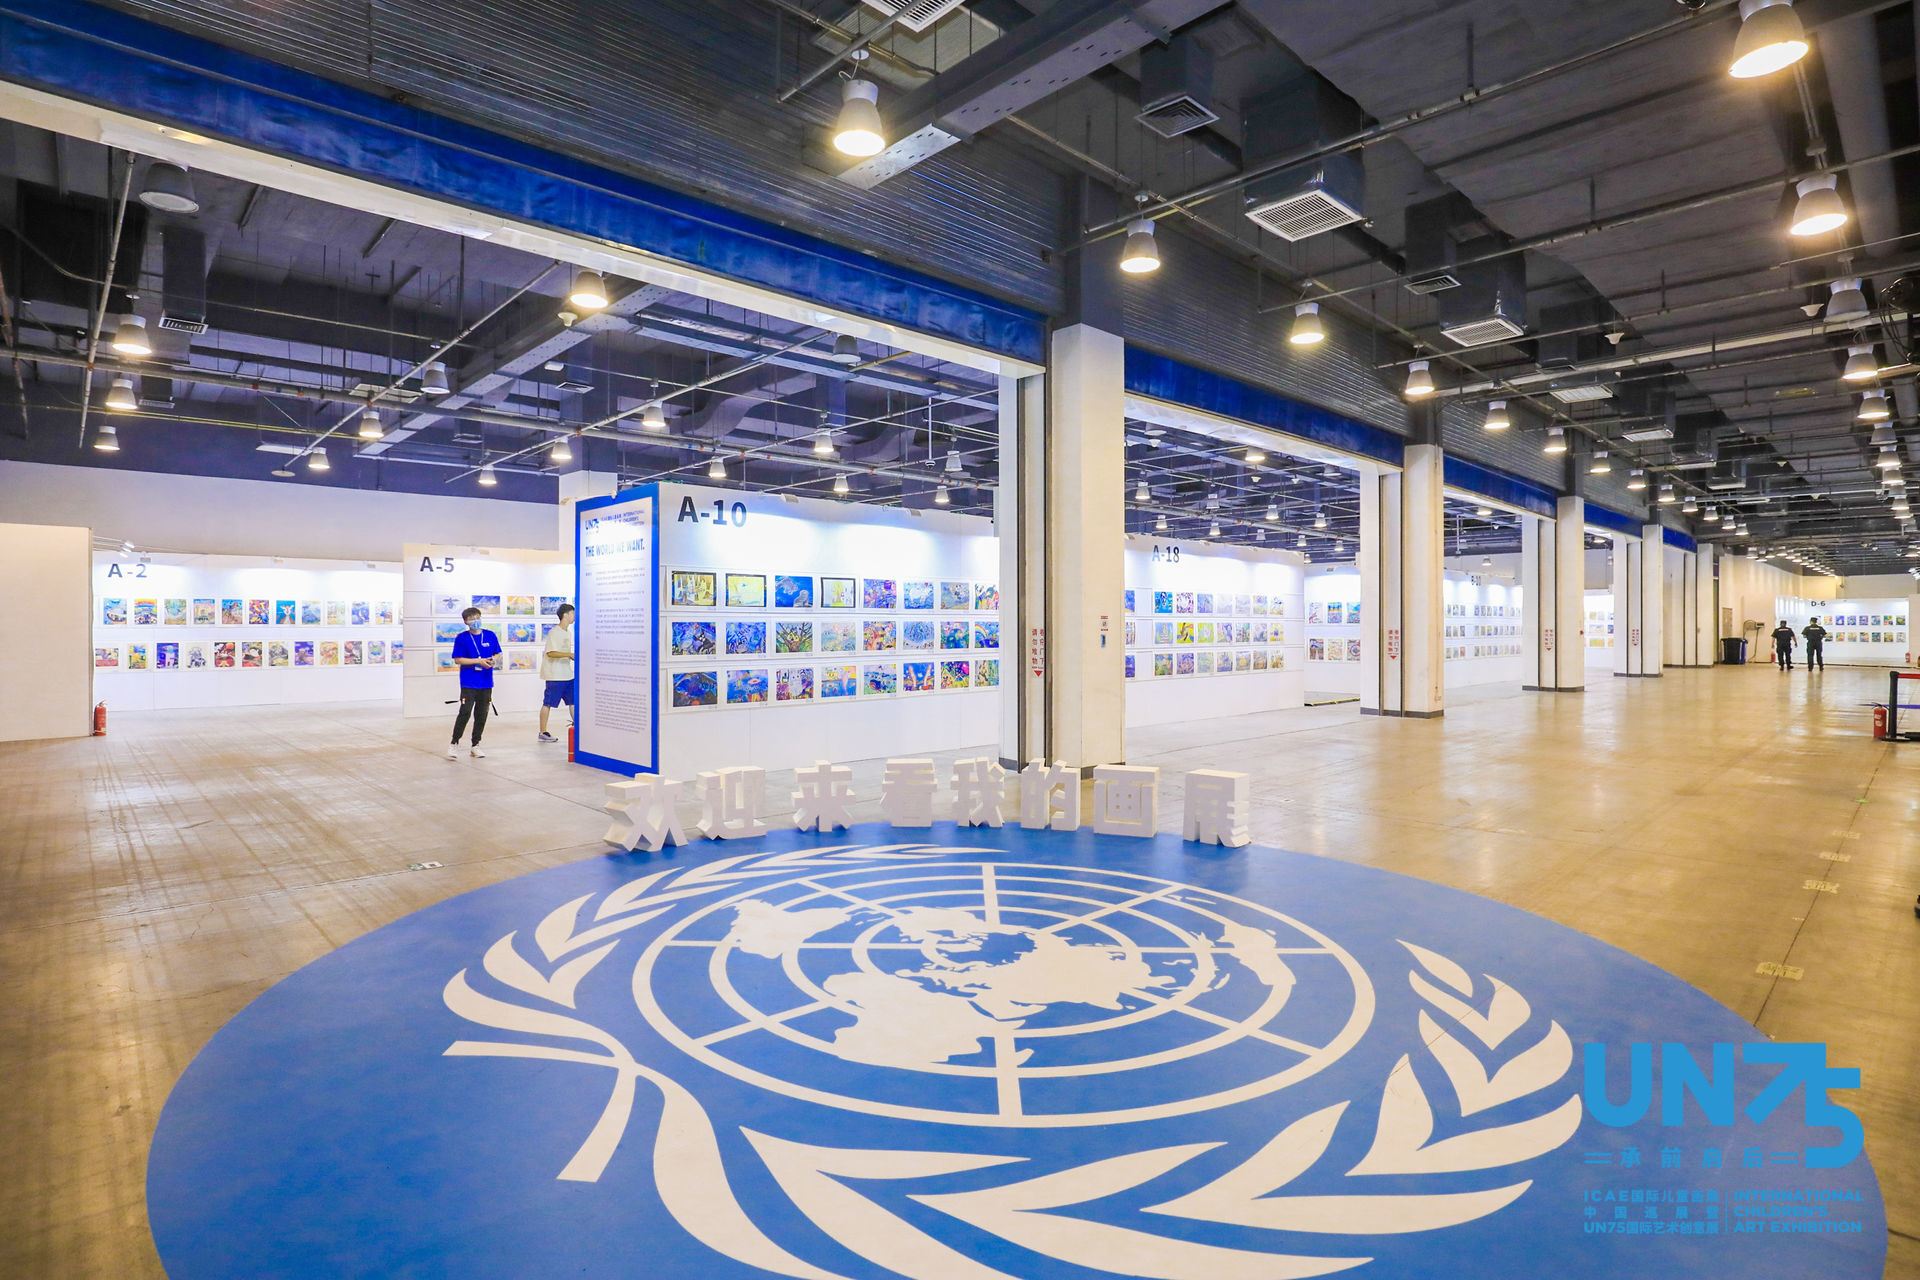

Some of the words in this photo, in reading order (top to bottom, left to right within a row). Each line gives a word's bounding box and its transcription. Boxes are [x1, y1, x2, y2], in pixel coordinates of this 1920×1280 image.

[677, 495, 747, 528] A-10
[1151, 544, 1180, 563] A-18
[107, 562, 148, 578] A-2
[419, 556, 455, 573] A-5
[603, 757, 1251, 850] 欢迎来看我的画展
